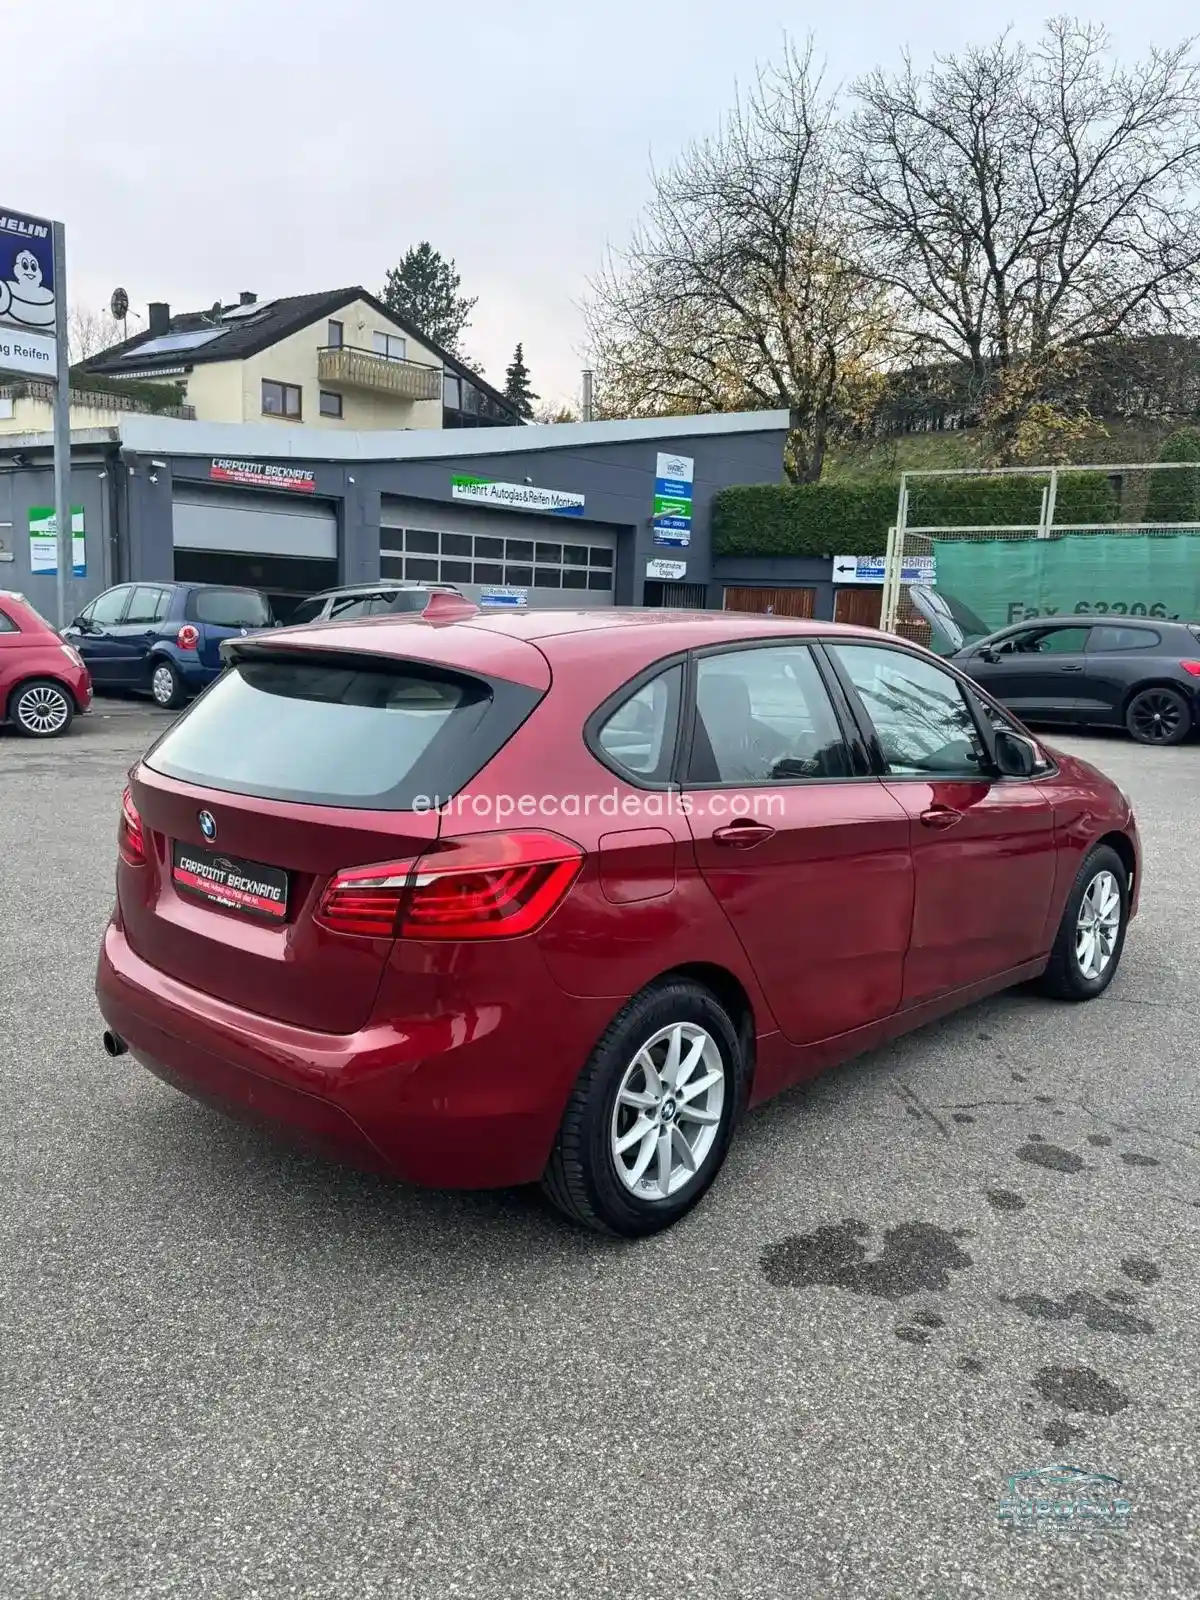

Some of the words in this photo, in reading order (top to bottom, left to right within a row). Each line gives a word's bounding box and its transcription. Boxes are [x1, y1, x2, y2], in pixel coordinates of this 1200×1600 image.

[14, 344, 50, 361] Reifen
[212, 458, 264, 474] CARPOINT
[265, 465, 315, 480] BACKNANG
[457, 480, 488, 496] Einfahrt
[180, 857, 226, 883] CARPOINT
[227, 874, 282, 901] BACKNANG
